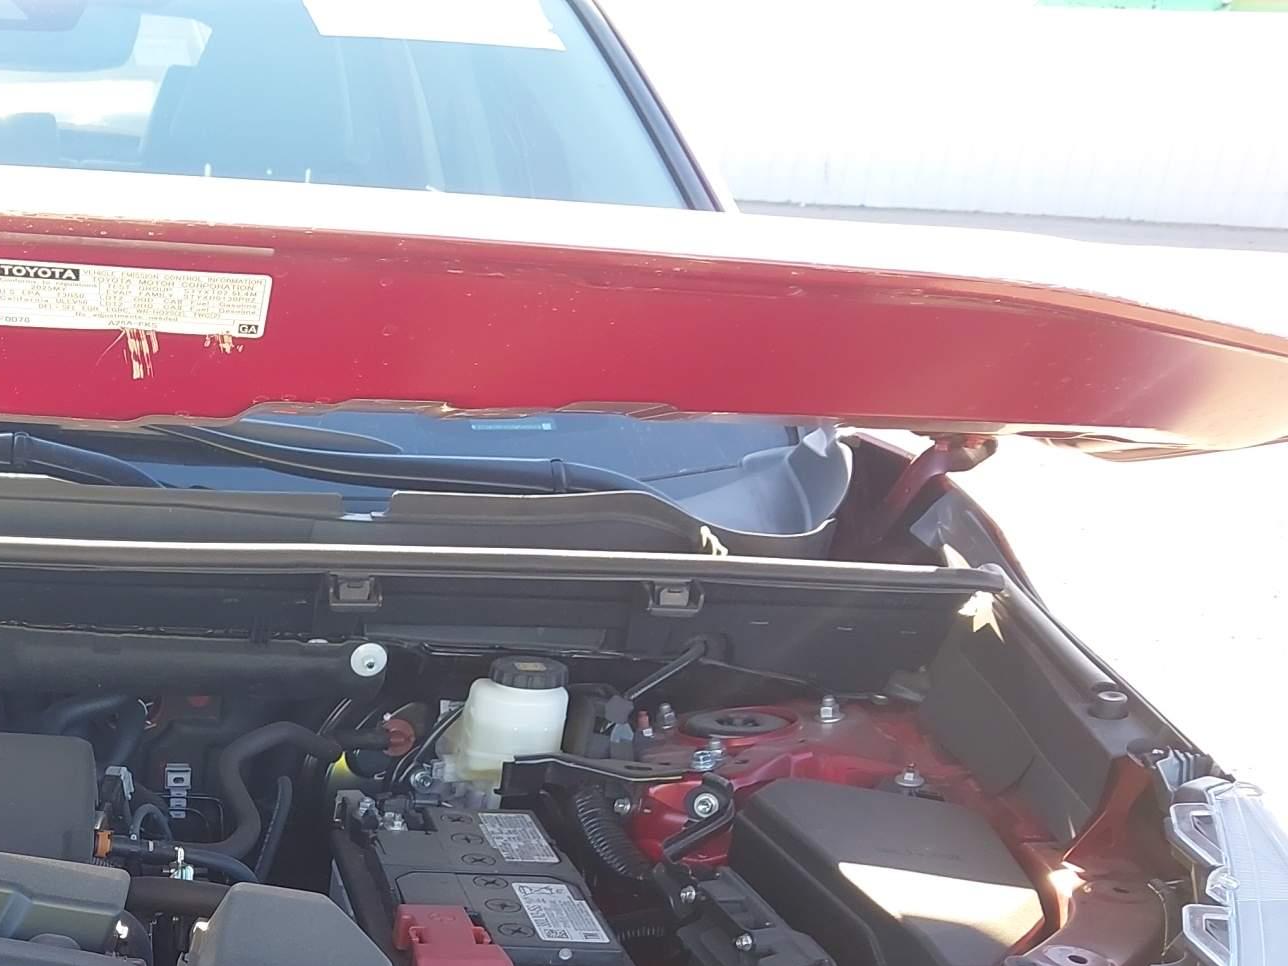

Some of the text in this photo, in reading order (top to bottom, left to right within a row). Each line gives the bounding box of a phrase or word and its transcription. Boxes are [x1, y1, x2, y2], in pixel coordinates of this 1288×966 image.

[0, 265, 76, 279] TOYOTA
[93, 276, 131, 284] TOYOTA
[181, 281, 253, 291] CORPORATION
[208, 277, 262, 285] INFORMATION
[239, 324, 256, 333] GA
